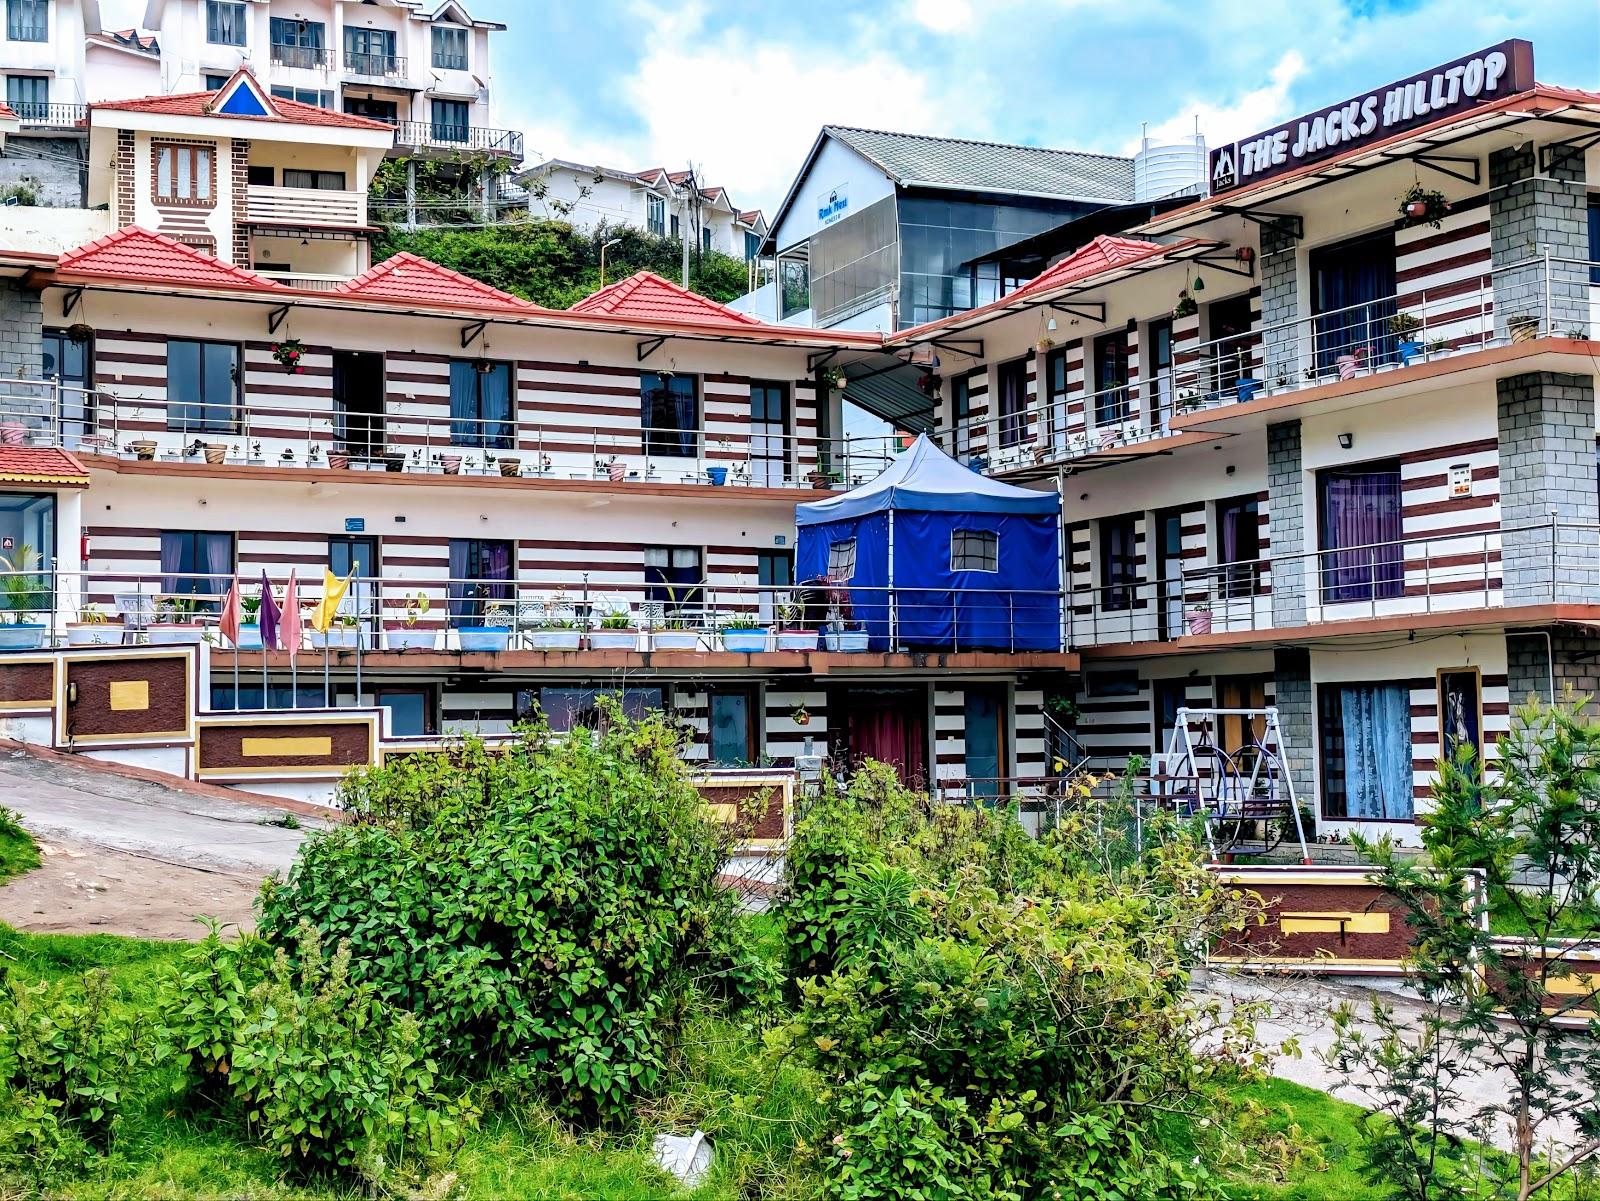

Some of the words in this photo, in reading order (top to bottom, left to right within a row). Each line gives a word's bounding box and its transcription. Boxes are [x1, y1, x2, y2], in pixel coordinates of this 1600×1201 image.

[1241, 130, 1289, 176] THE
[1292, 95, 1378, 158] JACKS
[1382, 51, 1507, 127] HILLTOP
